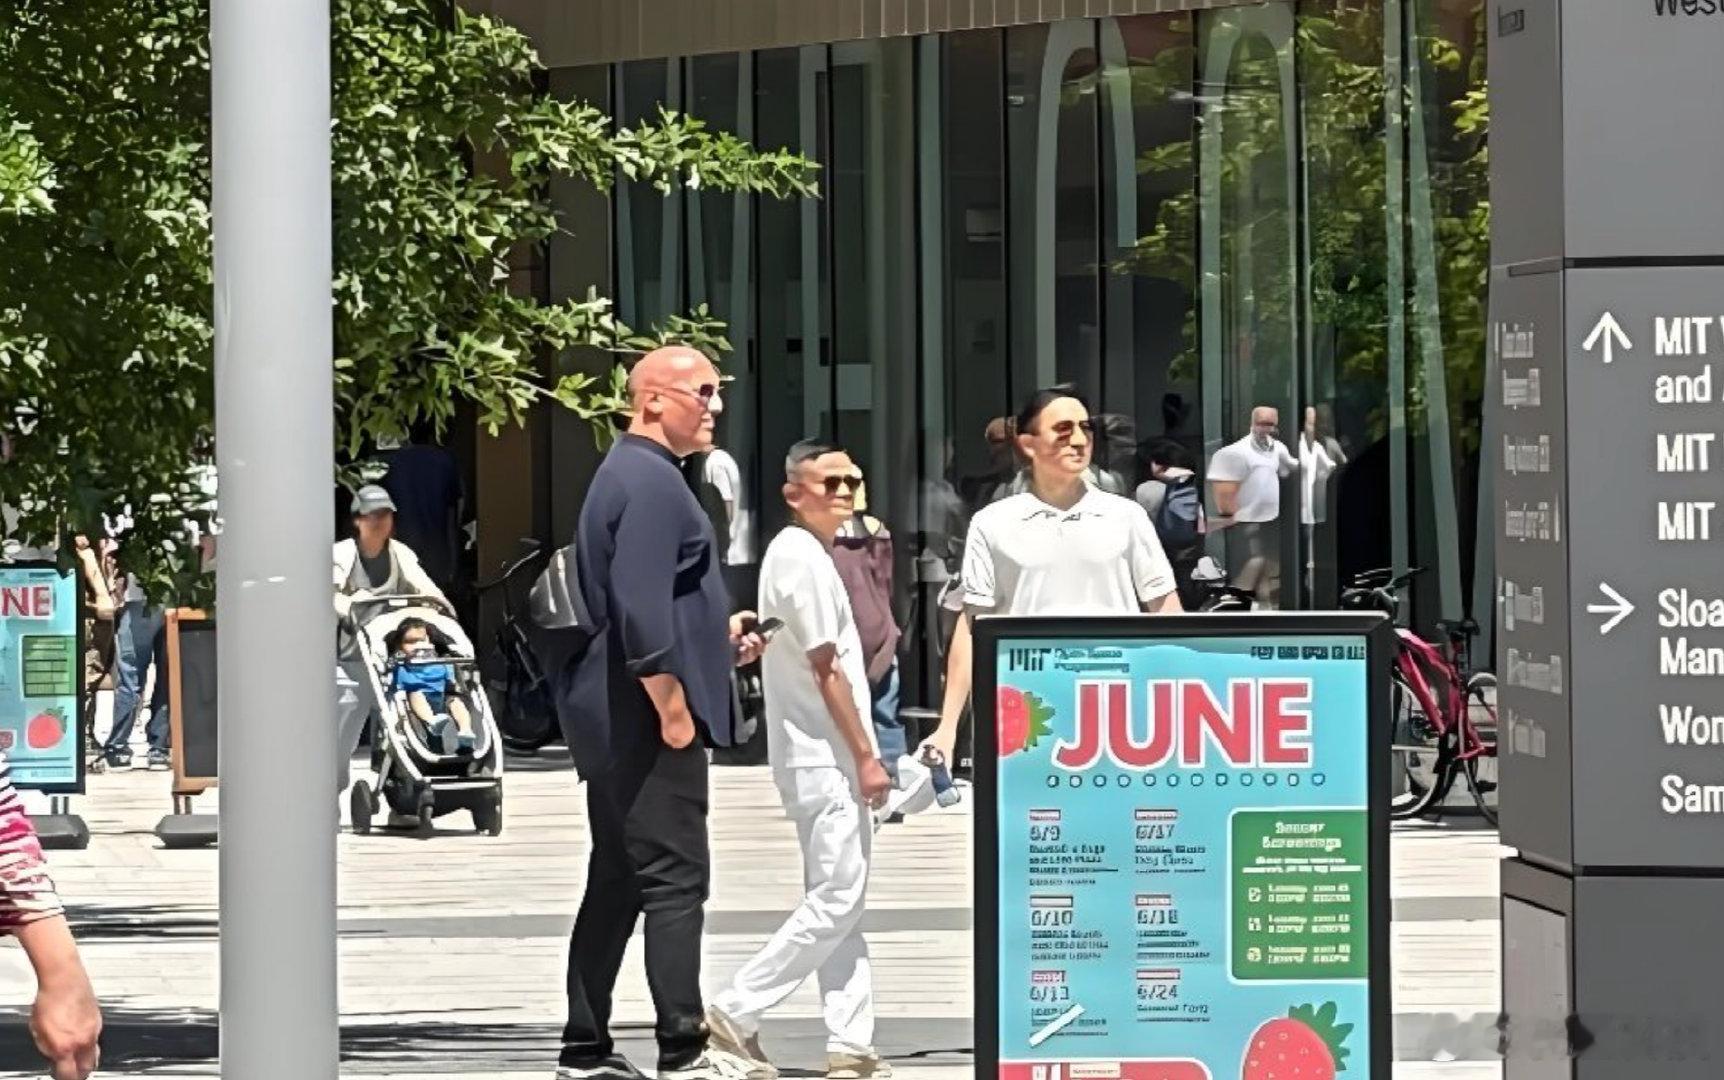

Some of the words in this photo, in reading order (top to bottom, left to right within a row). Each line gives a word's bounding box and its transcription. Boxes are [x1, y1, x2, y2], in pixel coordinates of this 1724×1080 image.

[1654, 0, 1724, 16] Wes
[1655, 316, 1713, 355] MIT
[1655, 364, 1711, 403] and
[1657, 433, 1715, 472] MIT
[1658, 501, 1716, 540] MIT
[1053, 679, 1312, 769] JUNE
